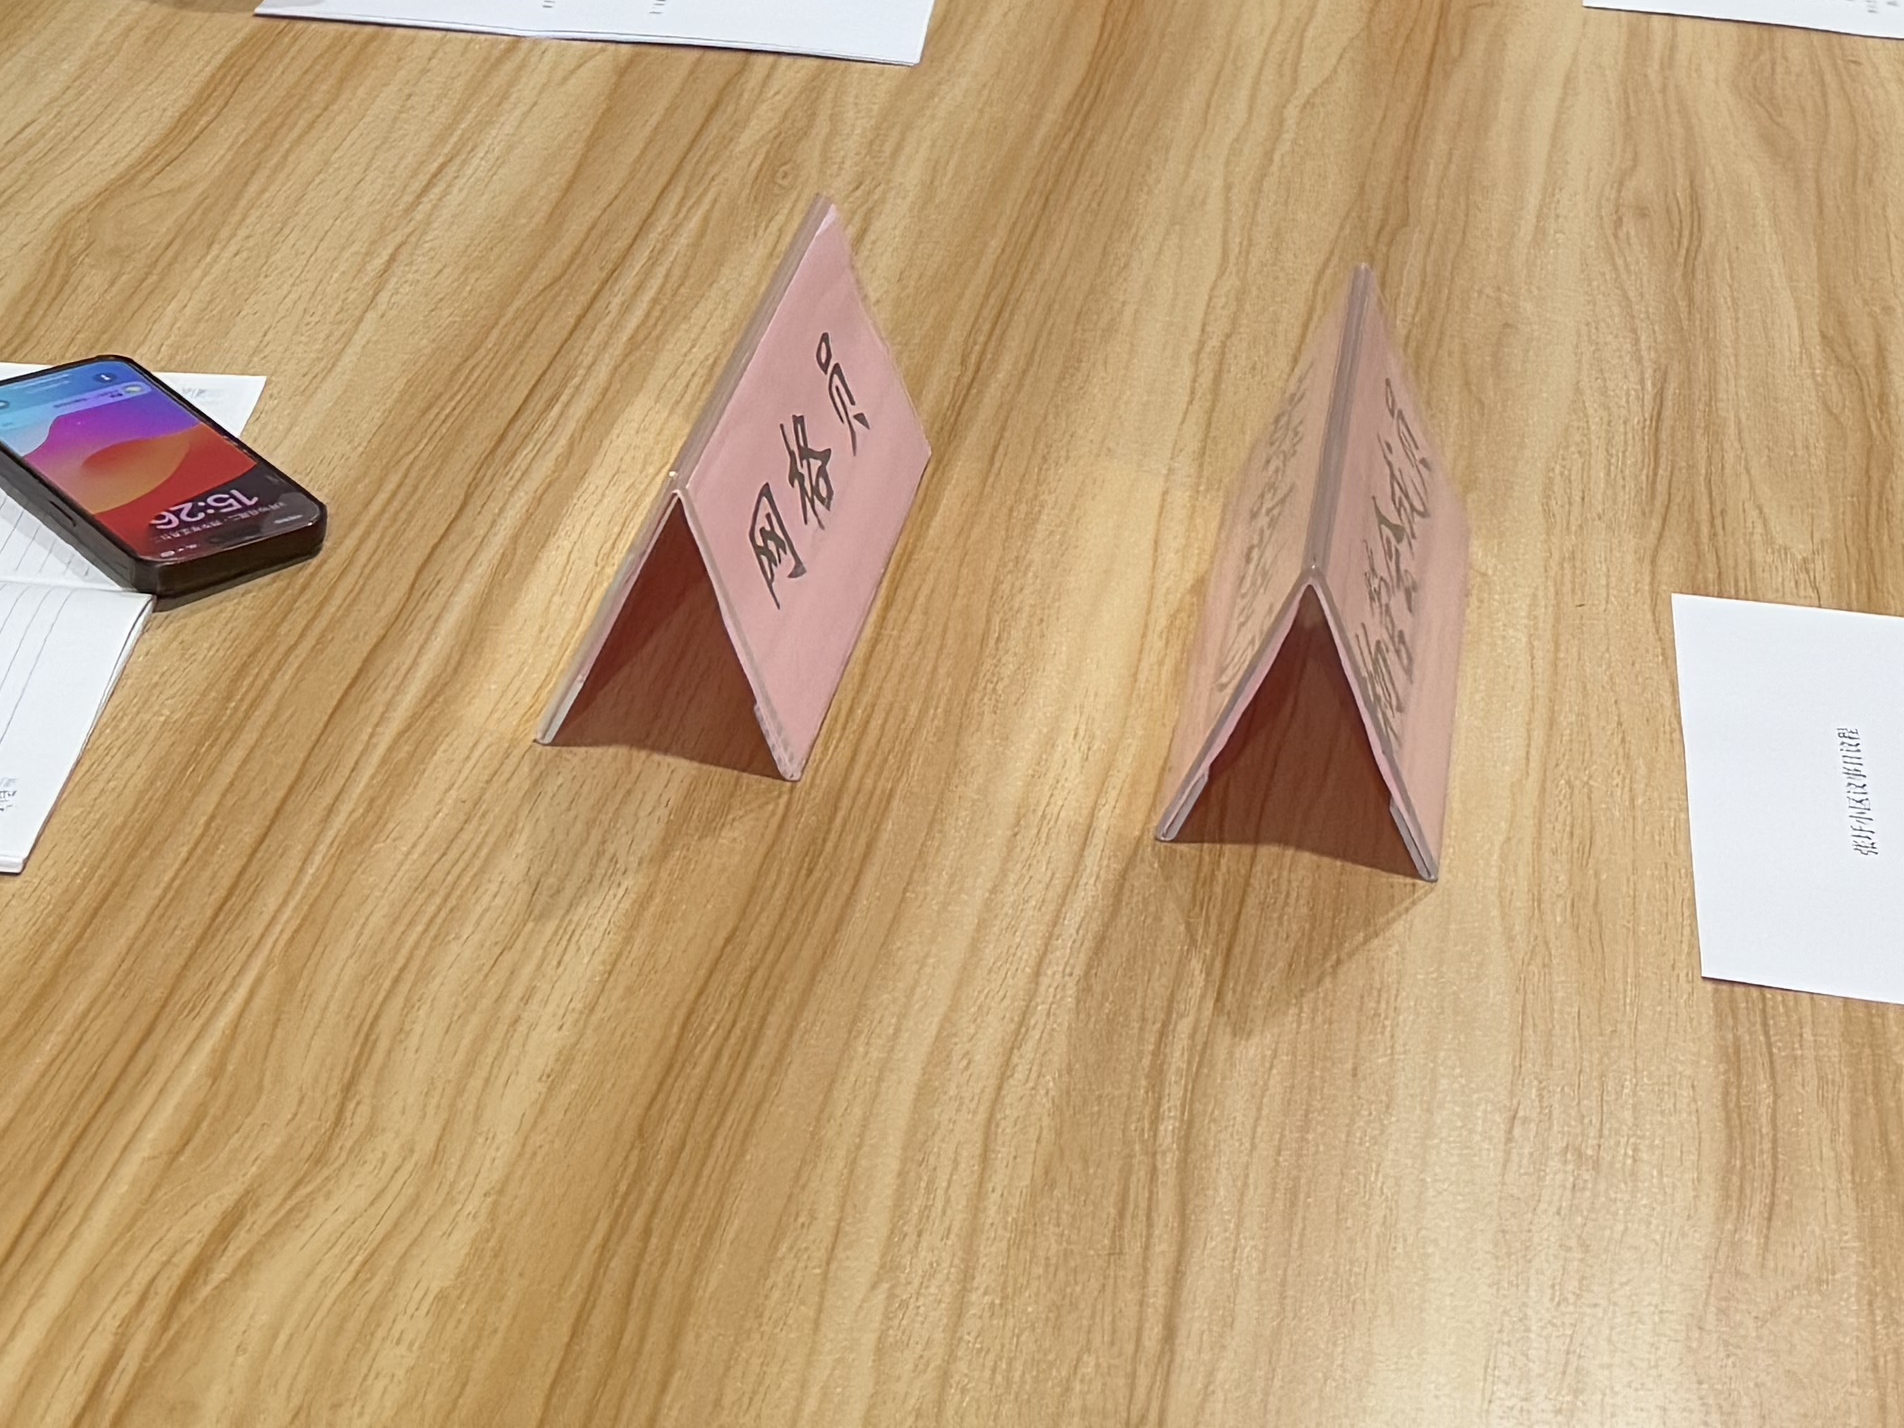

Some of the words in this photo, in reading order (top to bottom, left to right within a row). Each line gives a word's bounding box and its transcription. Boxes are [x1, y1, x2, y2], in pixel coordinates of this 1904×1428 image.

[150, 488, 259, 529] 15:26
[744, 330, 872, 611] 网格员
